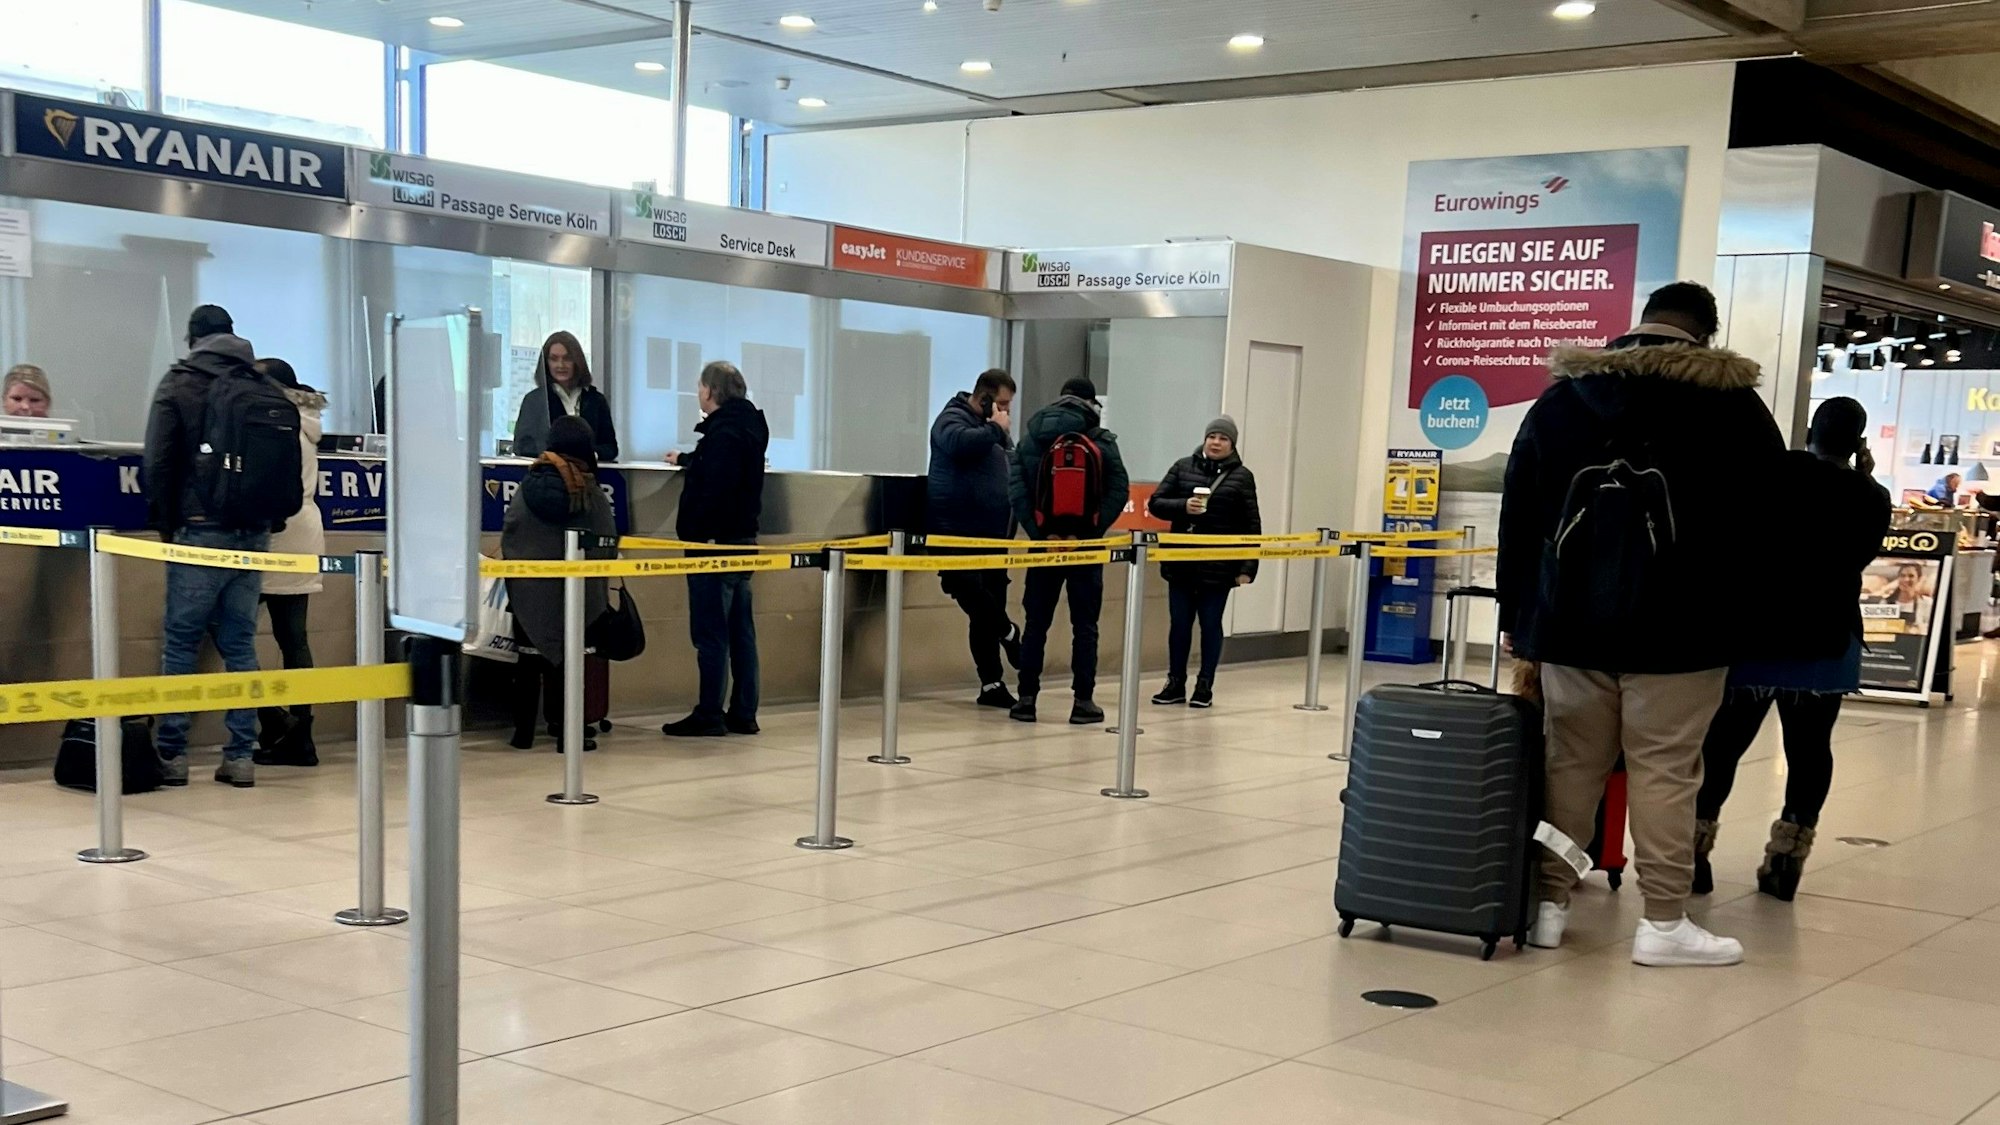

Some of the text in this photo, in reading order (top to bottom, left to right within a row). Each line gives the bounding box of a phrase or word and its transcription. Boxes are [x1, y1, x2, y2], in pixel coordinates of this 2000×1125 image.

[84, 116, 322, 188] RYANAIR
[394, 187, 433, 206] LOSCH
[1434, 191, 1539, 214] Eurowings
[441, 193, 597, 231] Passage Service Köln
[654, 223, 685, 241] LOSCH
[720, 234, 796, 258] Service Desk
[841, 243, 886, 259] easyJet
[1430, 238, 1605, 264] FLIEGEN SIE AUF
[896, 248, 966, 269] KUNDENSERVICE
[1038, 274, 1069, 286] LOSCH
[1077, 270, 1220, 289] Passage Service Köln
[1428, 269, 1614, 294] NUMMER SICHER.
[1440, 300, 1589, 315] Flexible Umbuchungsoptionen
[1438, 318, 1598, 331] Informiert mit dem Reiseberater
[1437, 336, 1515, 351] Rückholgarantie
[1517, 336, 1541, 348] nach
[1436, 354, 1530, 366] Corona-Reiseschutz
[1438, 397, 1470, 411] Jetzt
[1427, 414, 1480, 429] buchen!
[1397, 450, 1437, 458] RYANAIR
[0, 496, 62, 511] ERVICE
